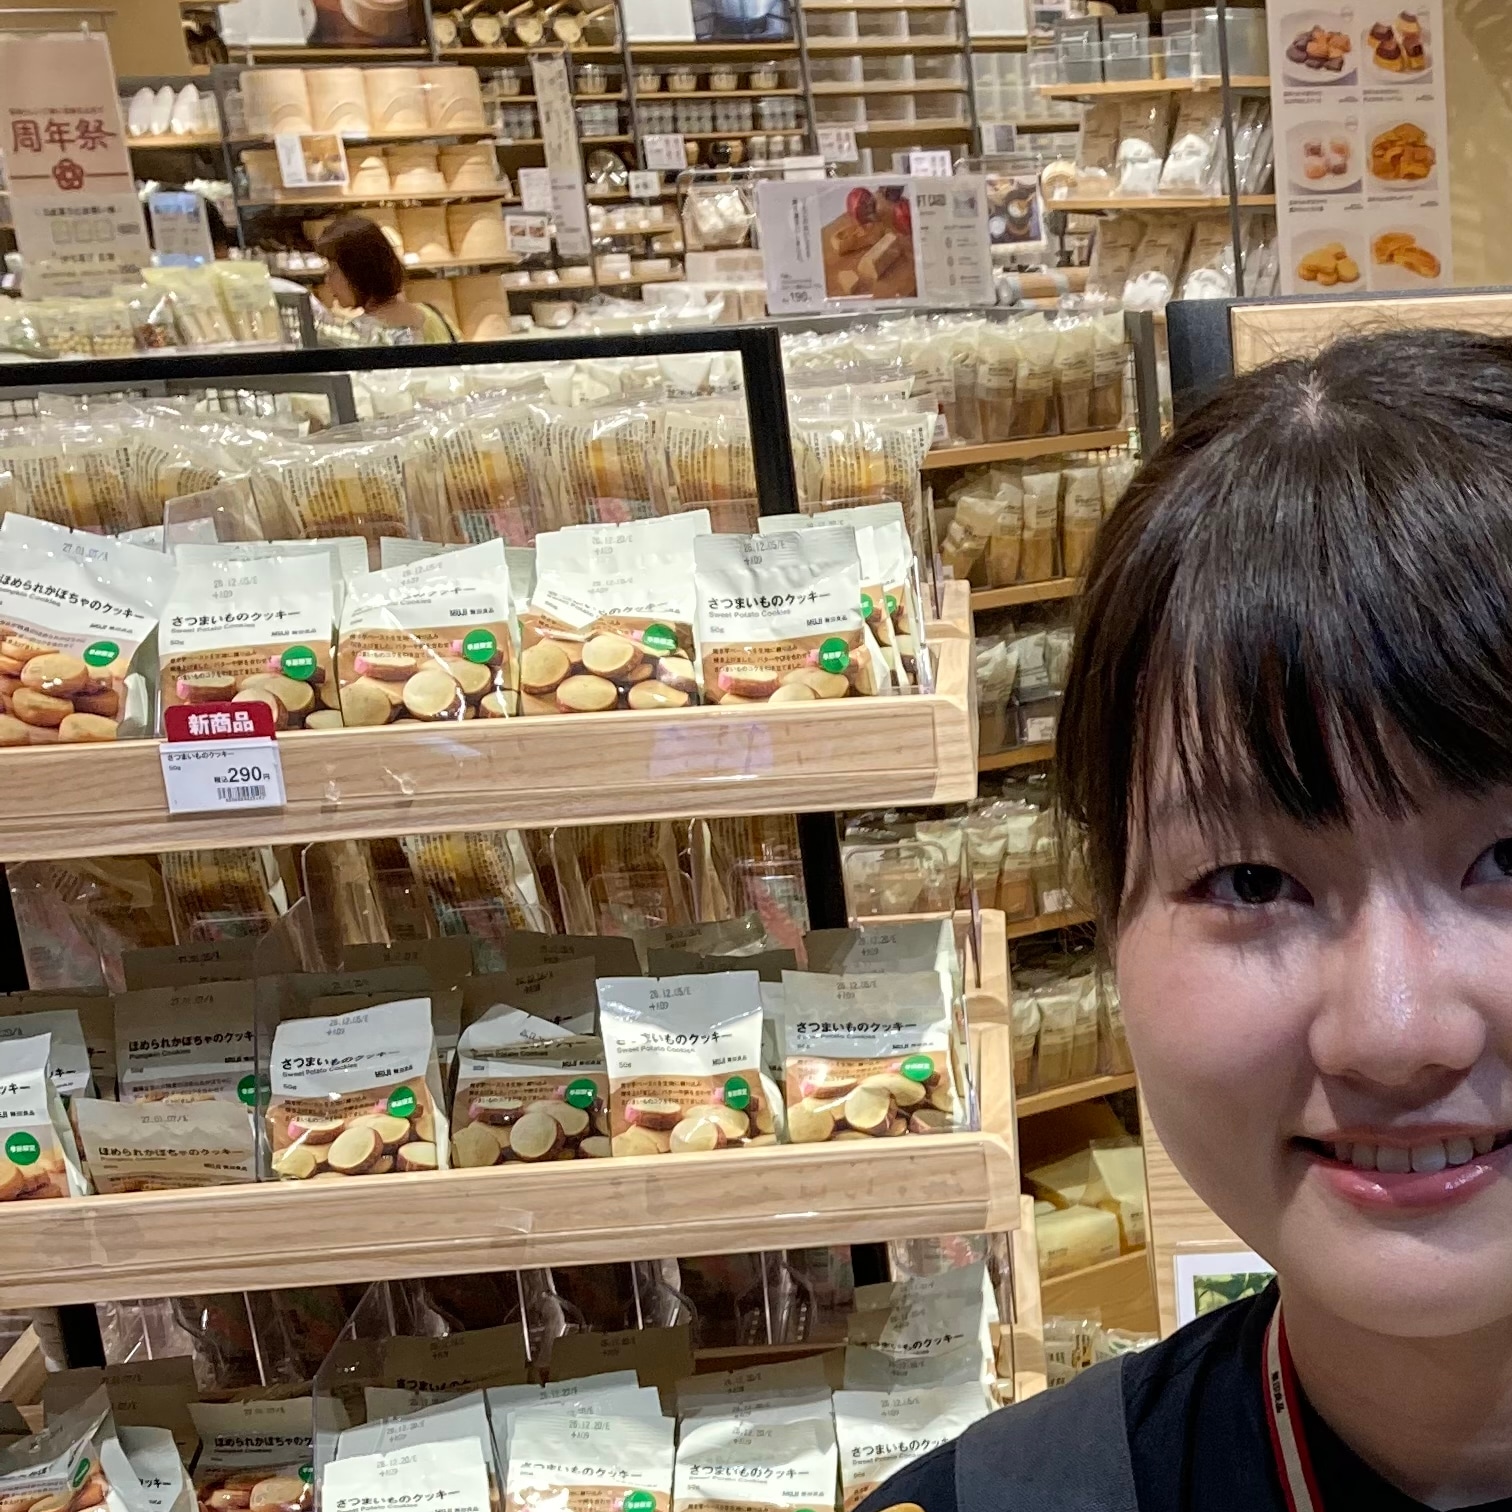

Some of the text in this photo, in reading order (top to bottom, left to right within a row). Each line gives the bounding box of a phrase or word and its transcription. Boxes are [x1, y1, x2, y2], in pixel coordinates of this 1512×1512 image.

[12, 118, 116, 152] 周年祭
[708, 592, 831, 610] さつまいものクッキー
[172, 610, 300, 627] さつまいものクッキー
[188, 712, 254, 736] 新商品
[797, 1022, 916, 1033] さつまいものクッキー
[336, 1490, 460, 1508] さつまいものクッキー
